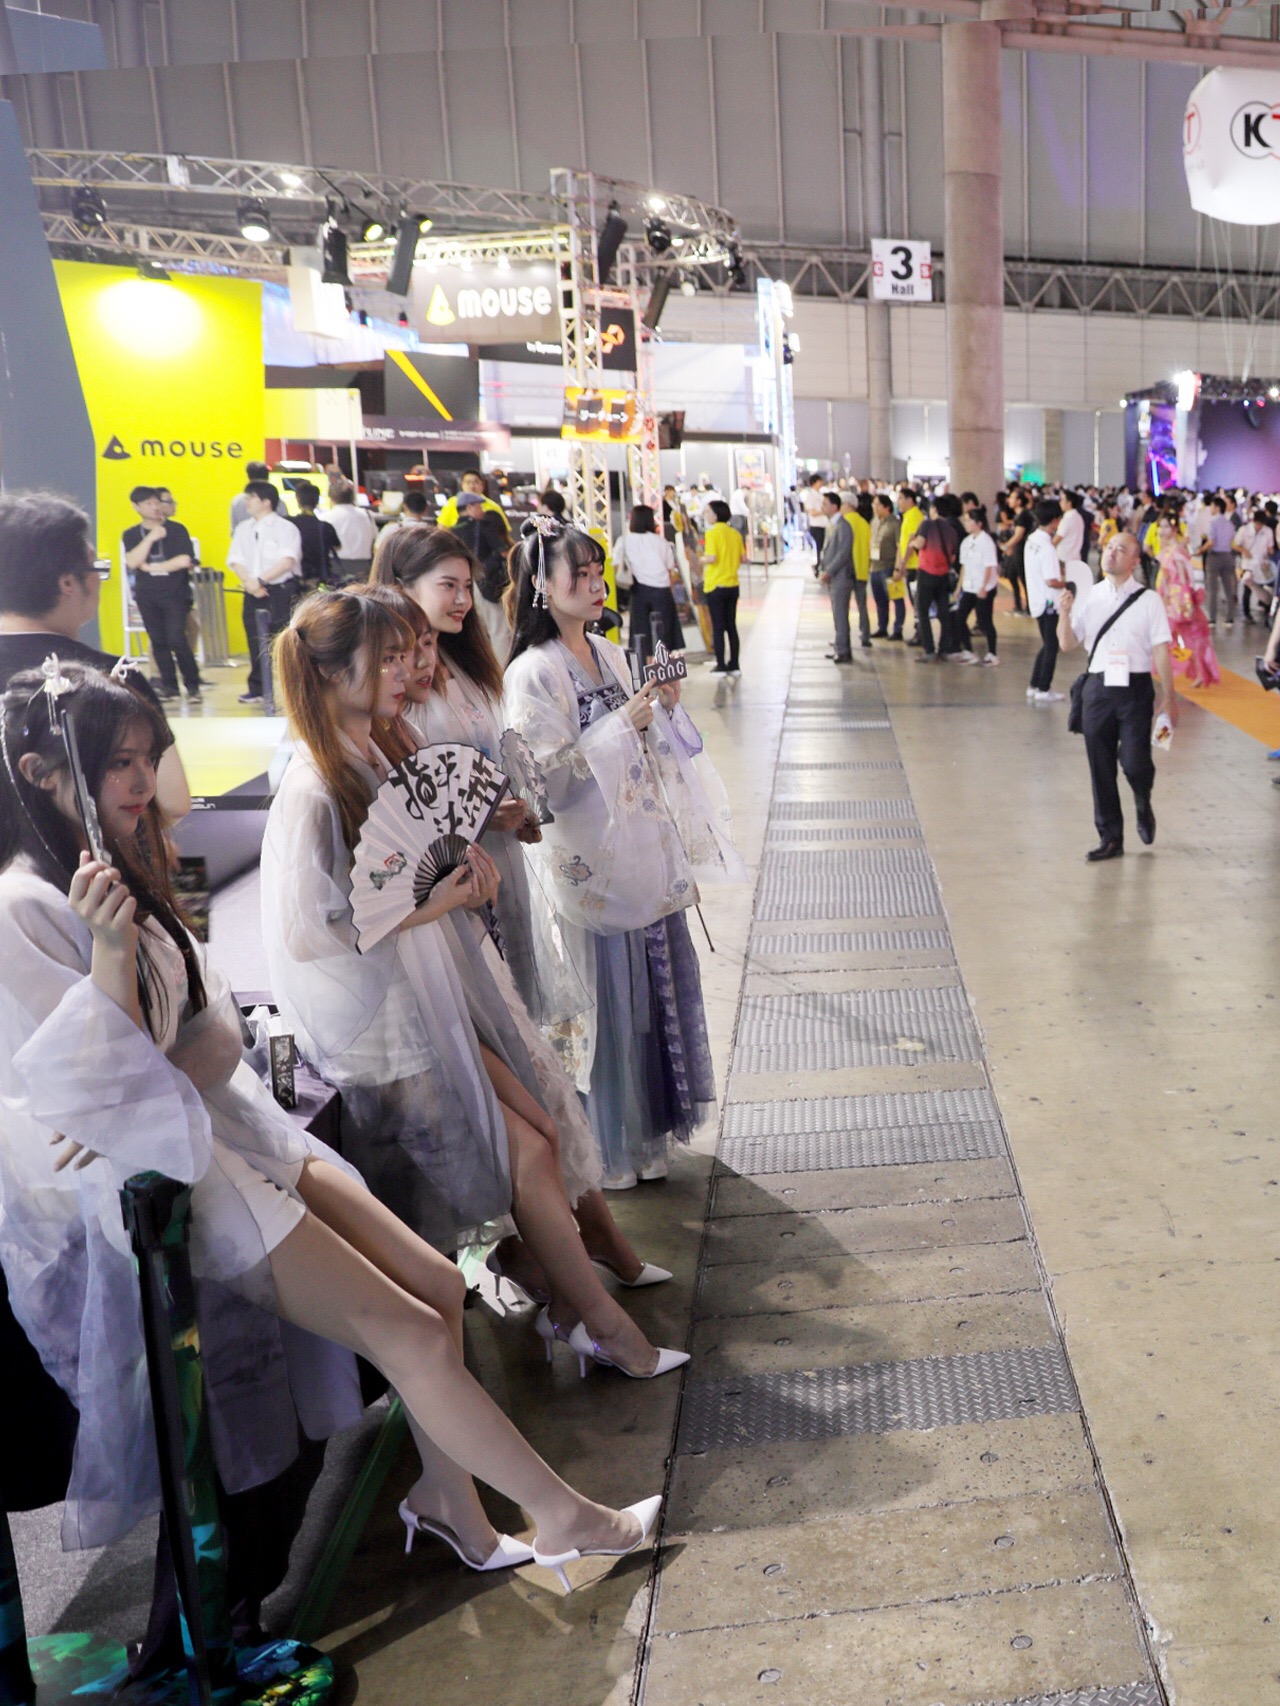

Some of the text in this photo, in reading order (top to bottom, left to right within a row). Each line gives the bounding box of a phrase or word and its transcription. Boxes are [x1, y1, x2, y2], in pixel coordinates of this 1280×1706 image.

[890, 246, 913, 280] 3
[457, 285, 552, 318] mouse
[891, 283, 914, 295] Hall
[141, 439, 243, 458] mouse
